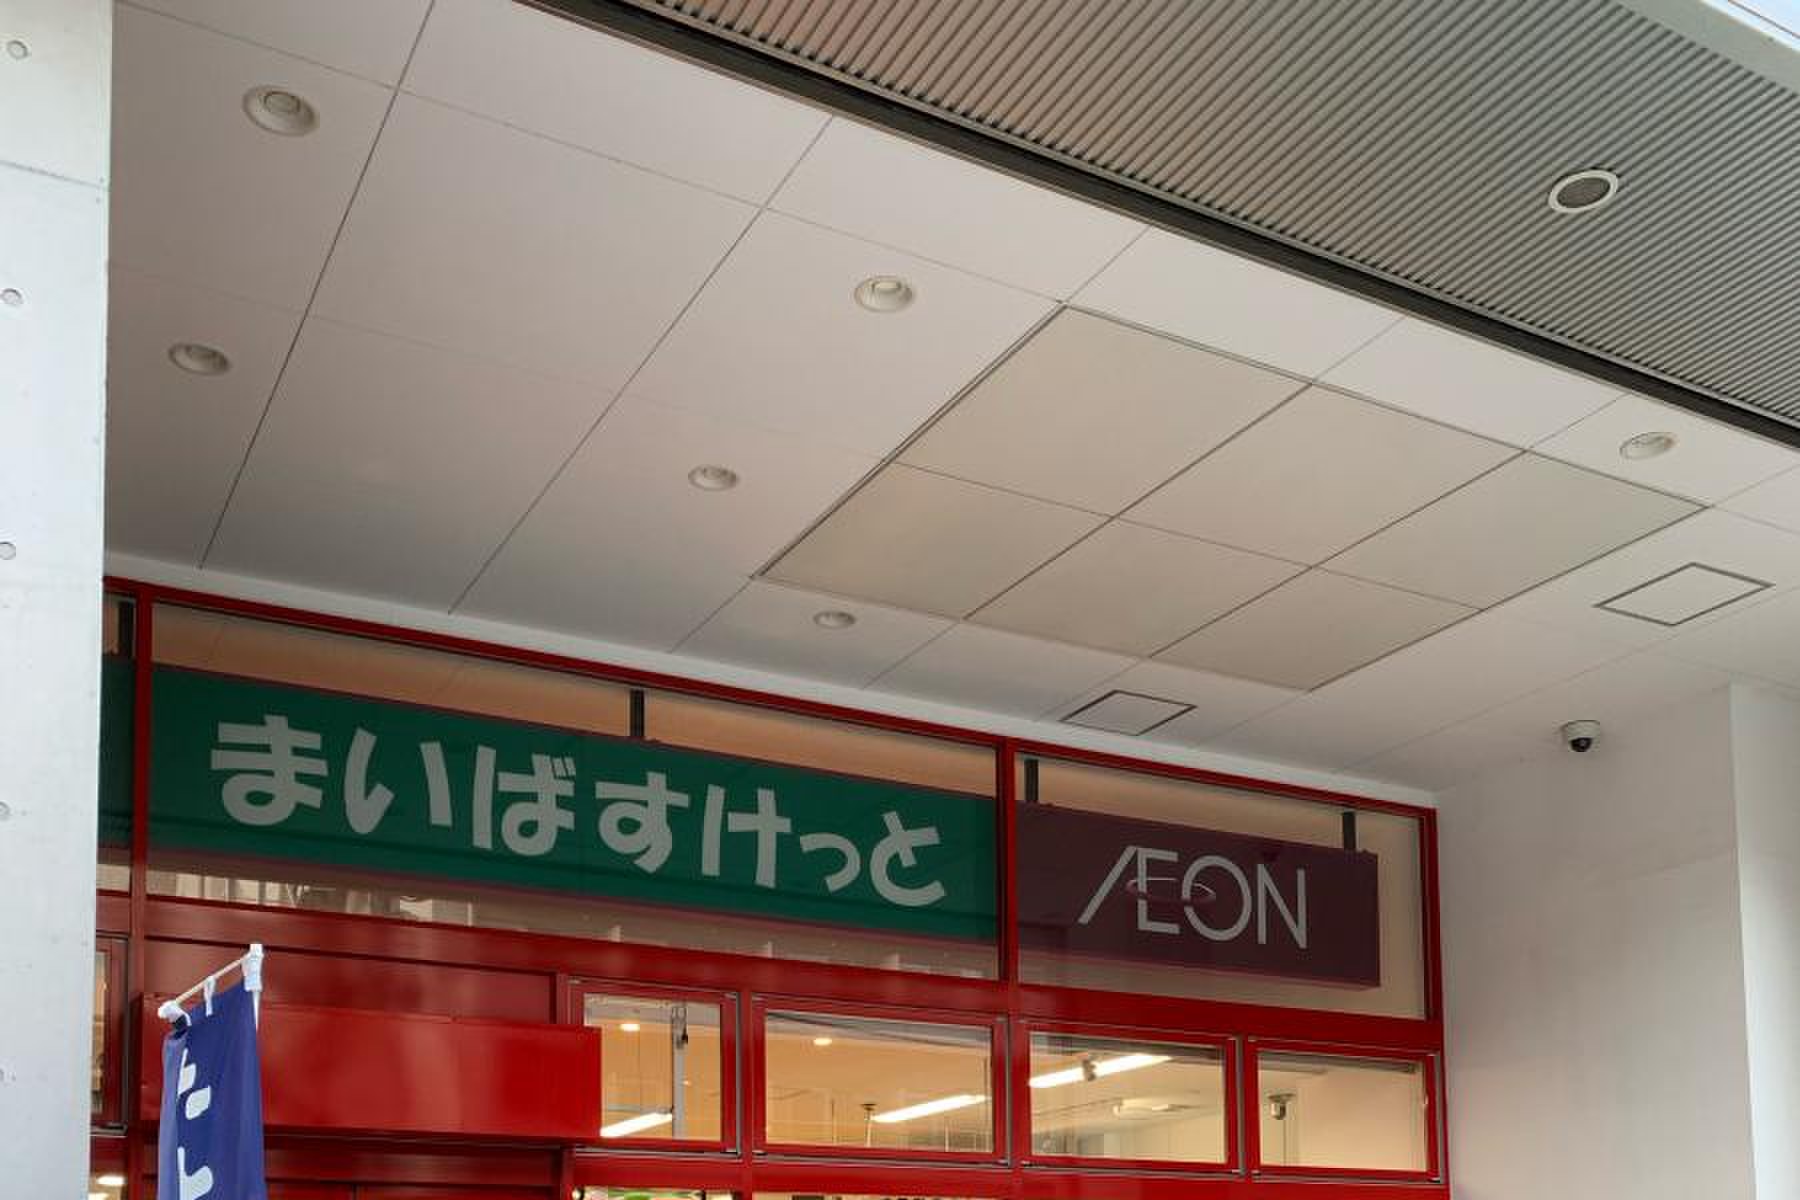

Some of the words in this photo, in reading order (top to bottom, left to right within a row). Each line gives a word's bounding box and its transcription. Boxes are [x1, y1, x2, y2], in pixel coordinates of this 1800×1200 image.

[210, 714, 946, 908] まいばすけっと
